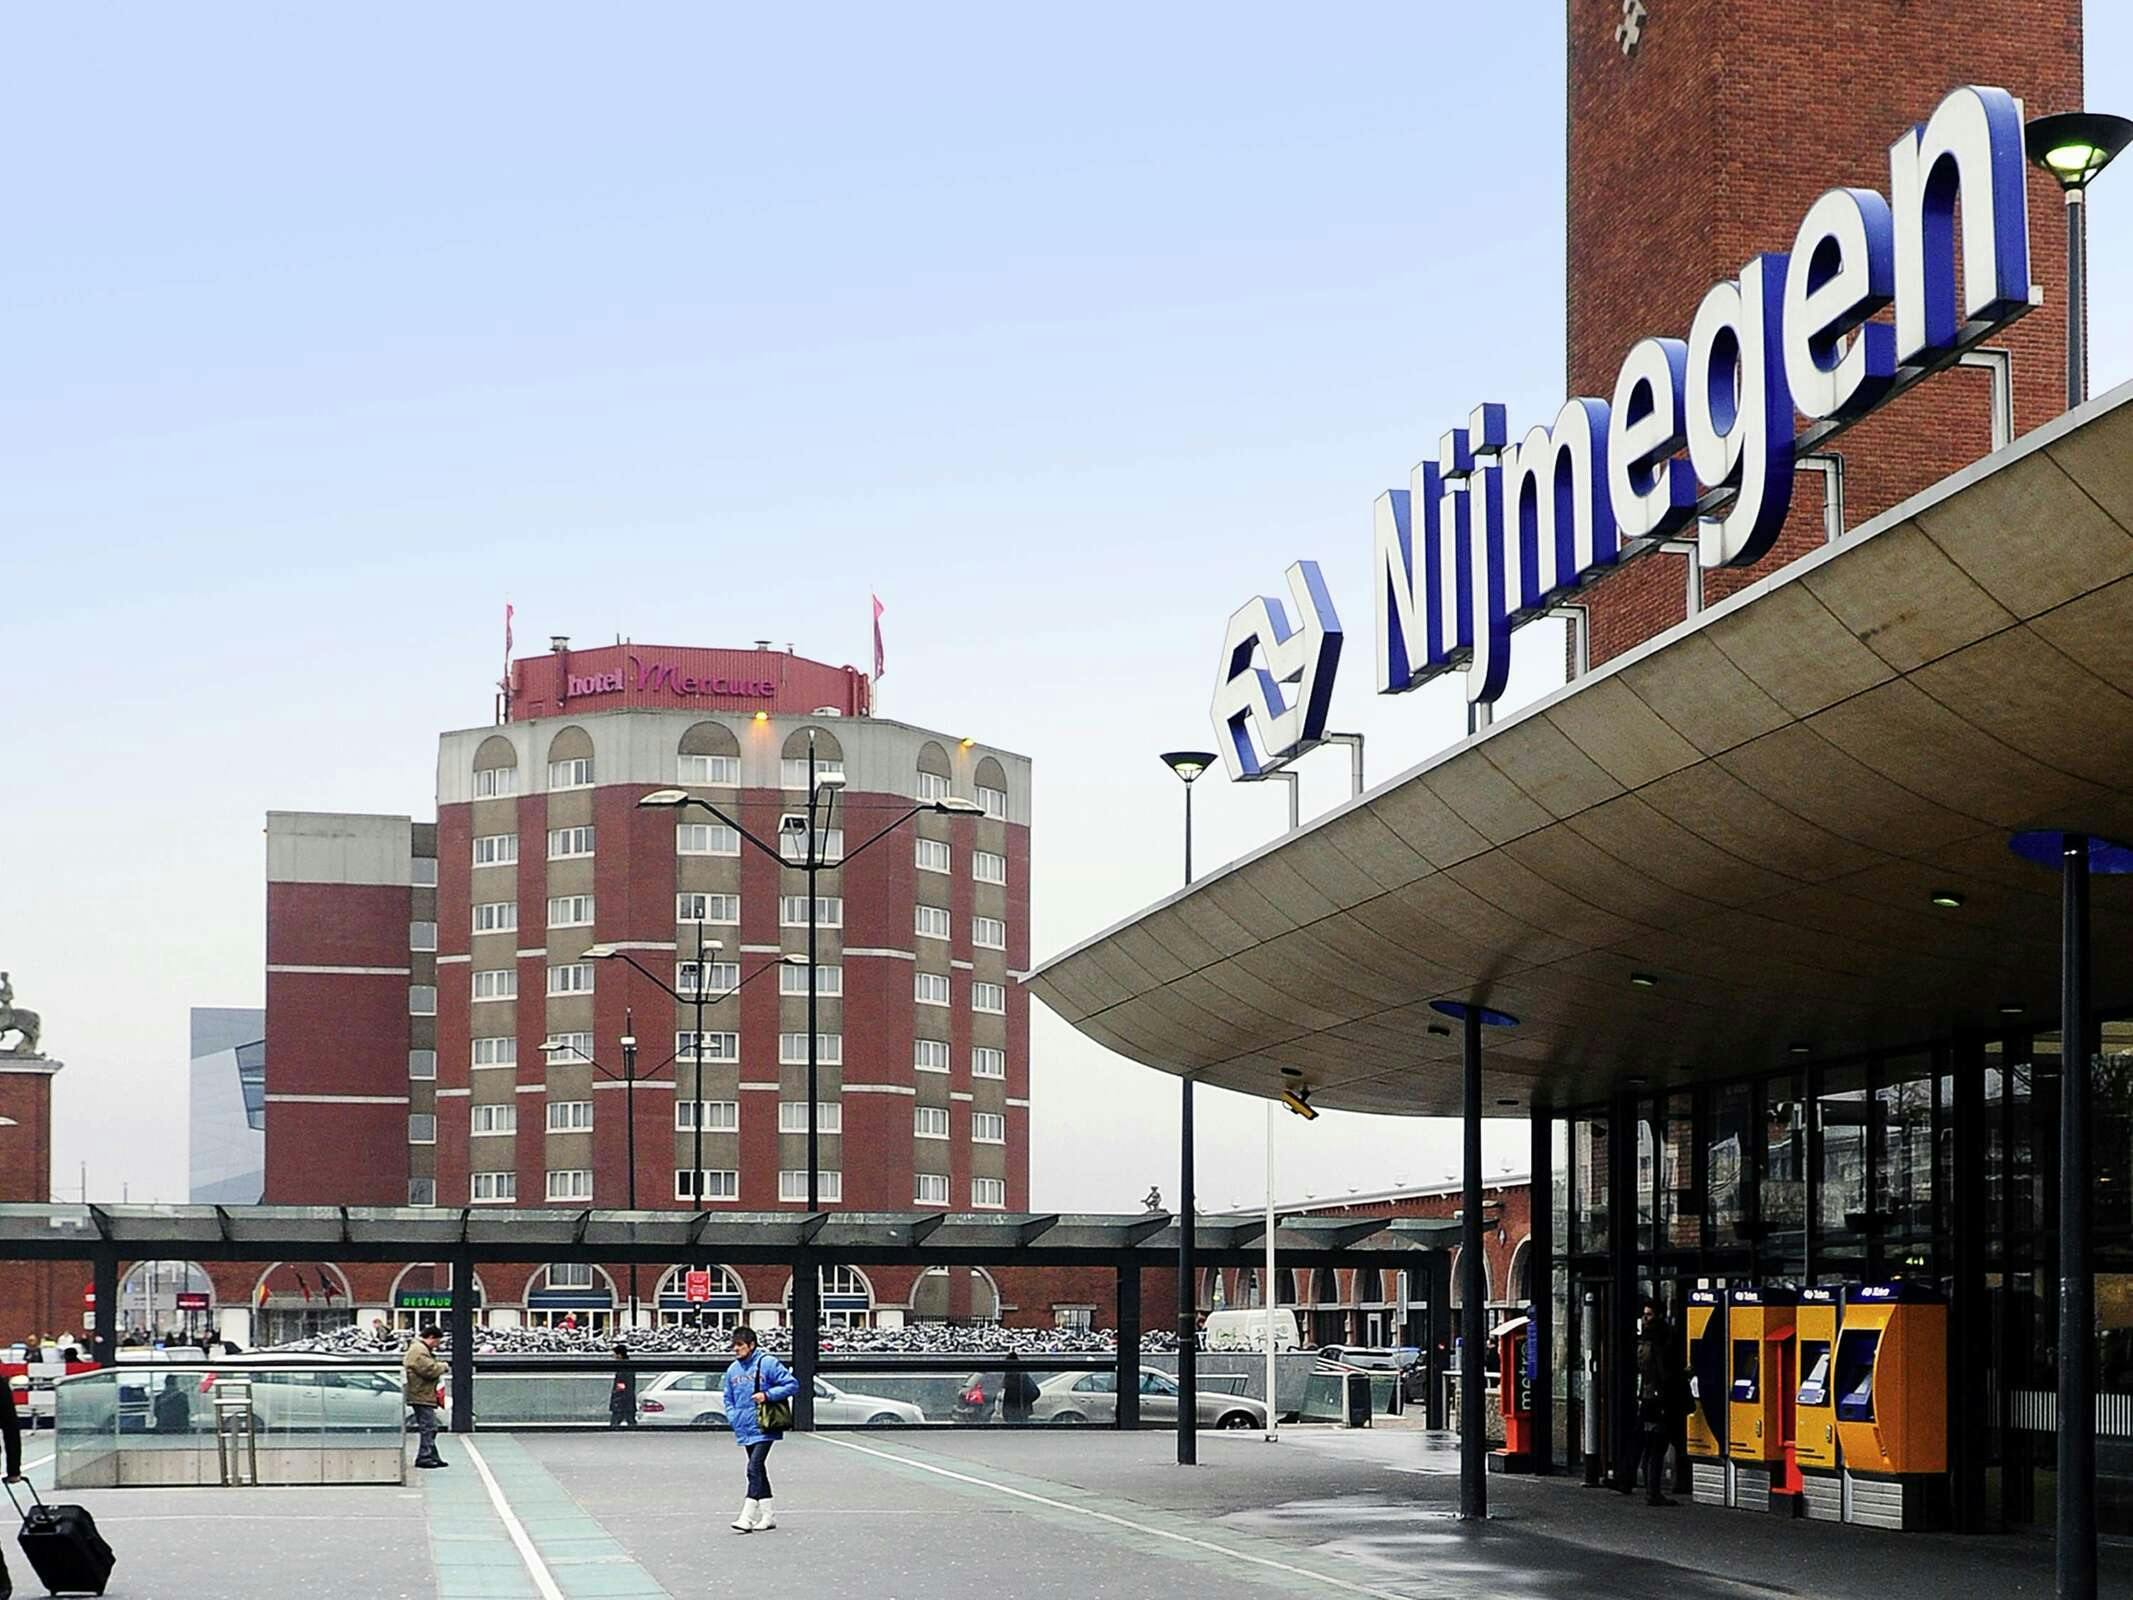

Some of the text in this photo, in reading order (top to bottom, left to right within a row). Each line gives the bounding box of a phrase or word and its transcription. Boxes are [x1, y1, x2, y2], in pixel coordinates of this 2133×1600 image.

[1374, 86, 2030, 704] Nijmegen
[567, 656, 777, 698] hotel Mercure
[403, 1297, 452, 1307] RESTAUR
